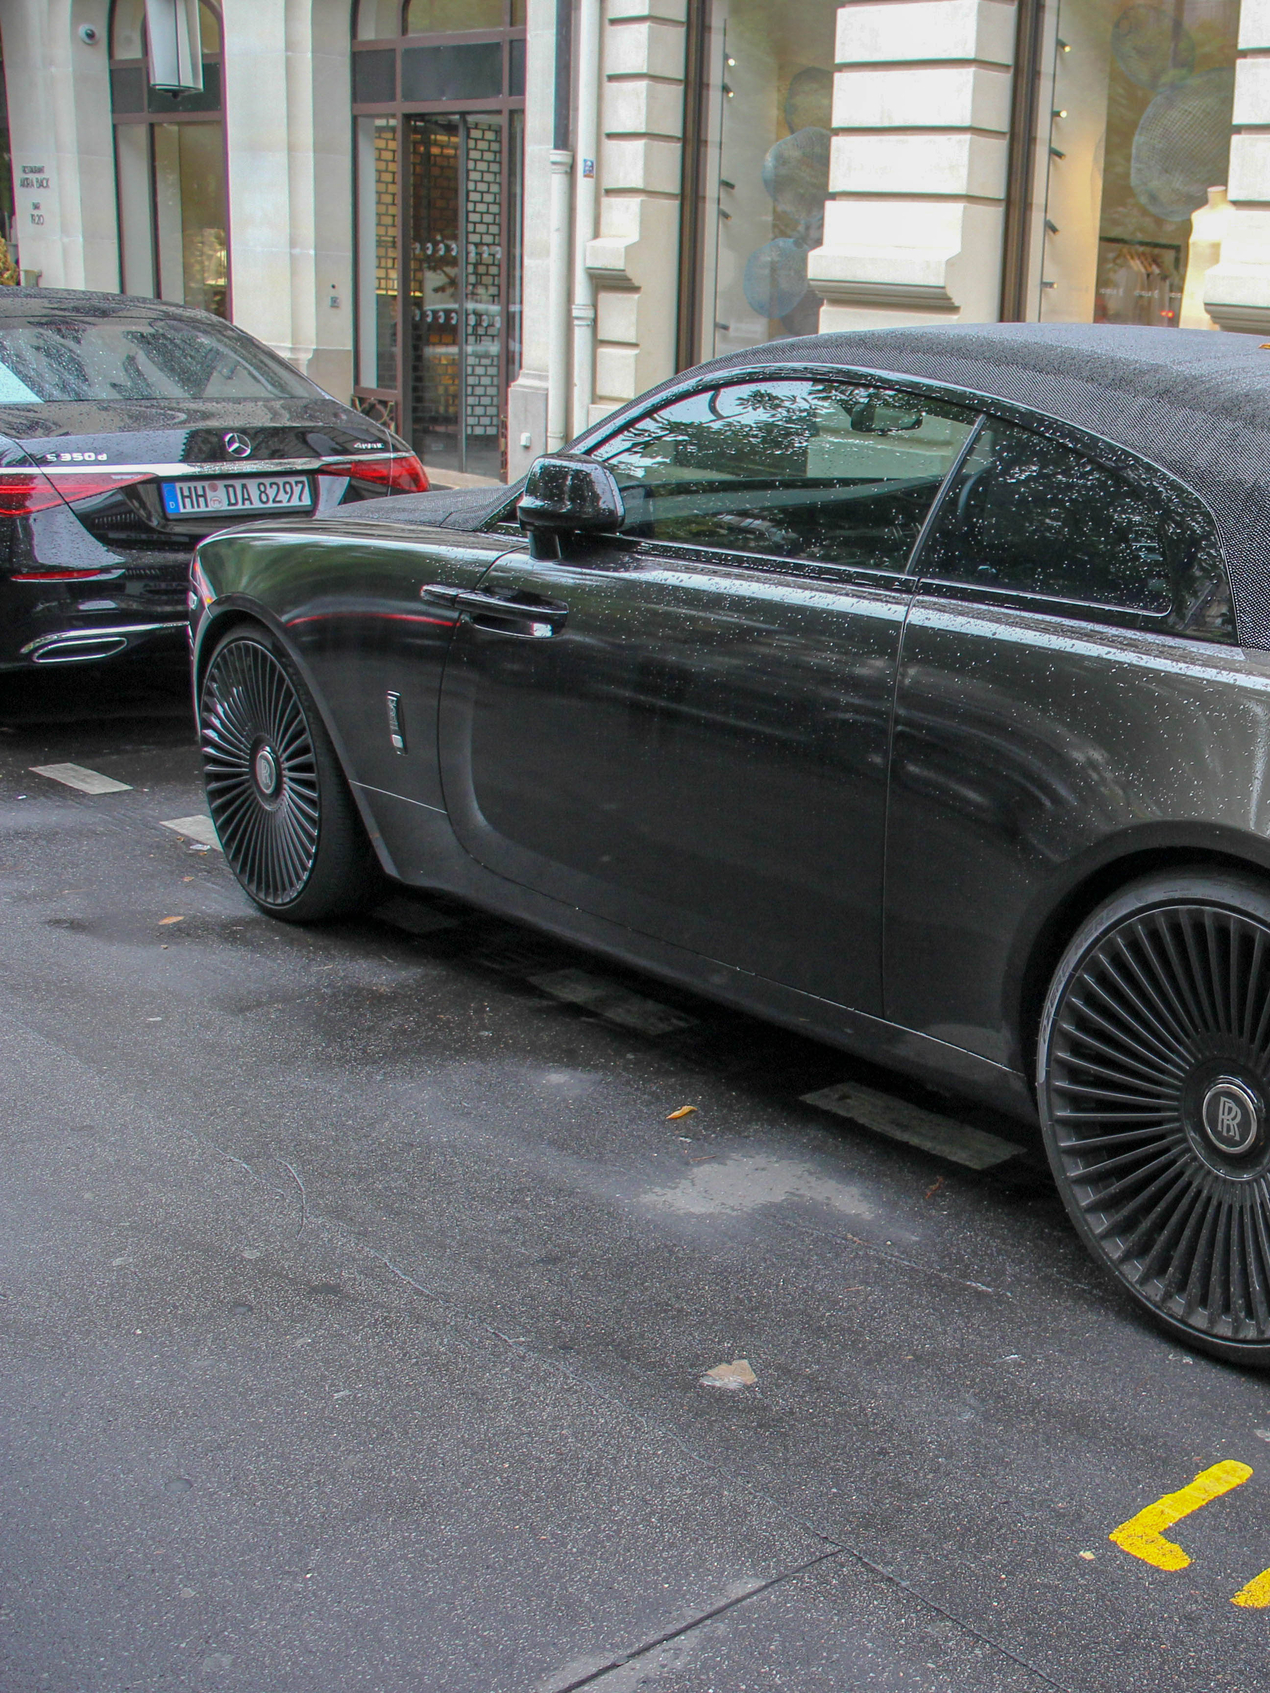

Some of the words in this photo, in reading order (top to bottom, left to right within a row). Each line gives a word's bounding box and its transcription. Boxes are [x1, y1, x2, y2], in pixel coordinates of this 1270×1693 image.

[180, 485, 209, 509] HH
[224, 483, 254, 507] DA
[257, 480, 306, 505] 8297
[169, 501, 176, 509] D
